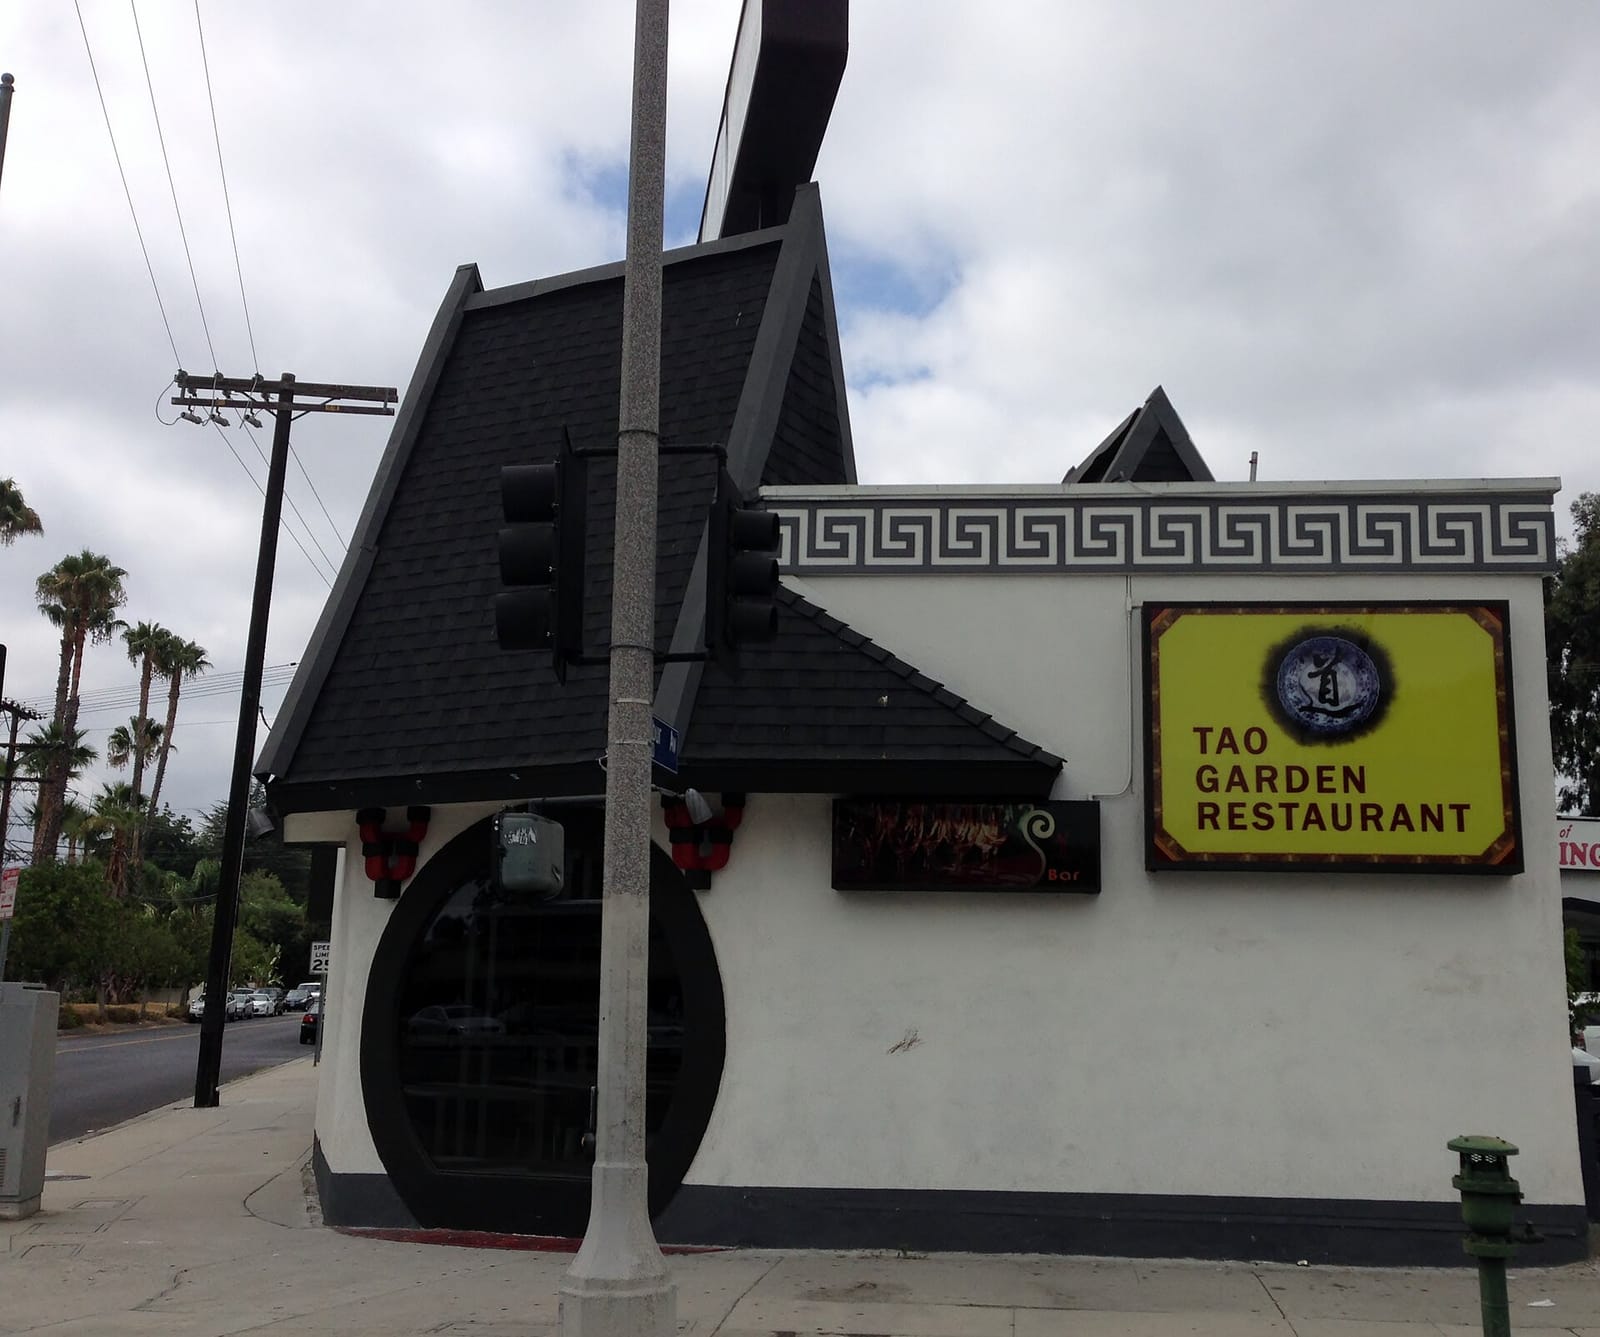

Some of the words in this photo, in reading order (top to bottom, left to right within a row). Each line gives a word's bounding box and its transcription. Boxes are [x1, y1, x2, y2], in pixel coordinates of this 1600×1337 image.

[1193, 726, 1267, 755] TAO
[1195, 764, 1366, 794] GARDEN
[1197, 801, 1471, 833] RESTAURANT
[1559, 824, 1573, 838] of
[1047, 868, 1080, 881] Bar
